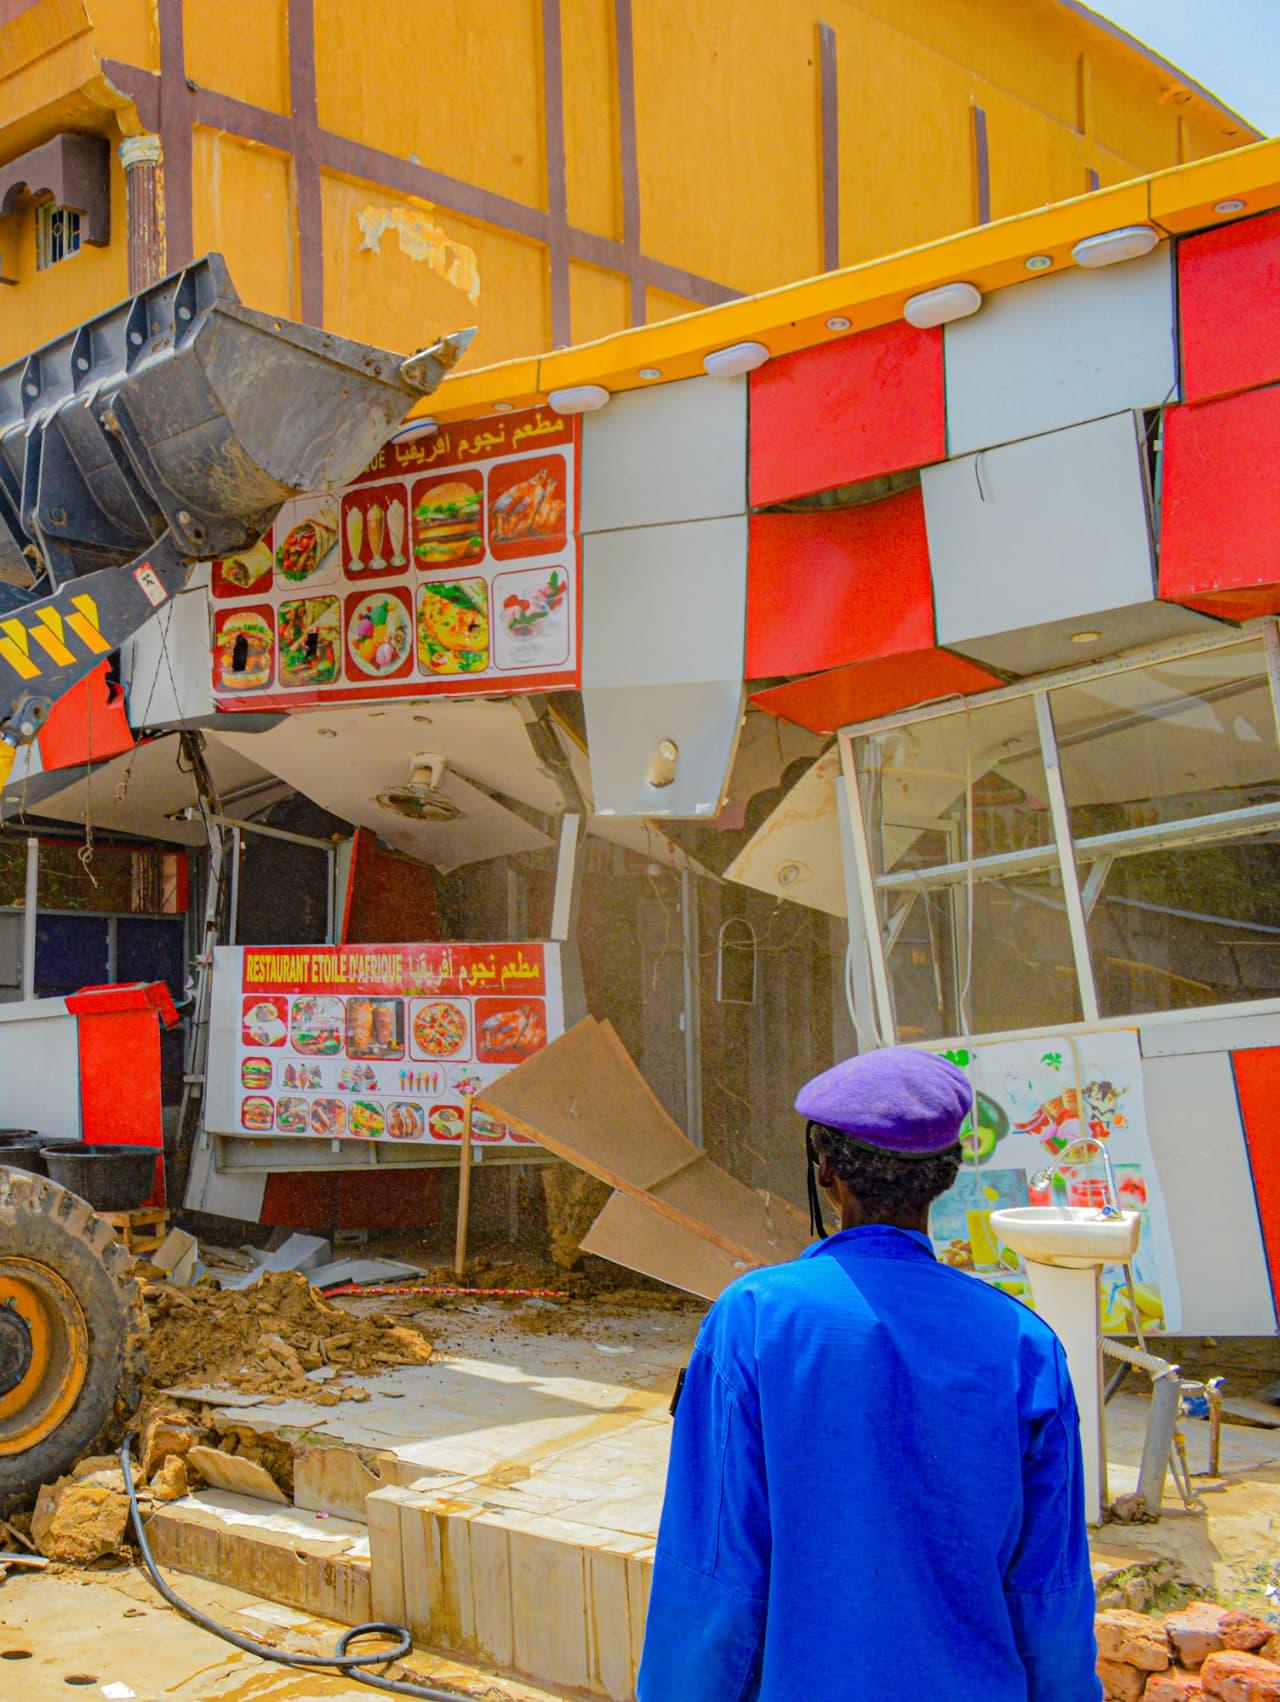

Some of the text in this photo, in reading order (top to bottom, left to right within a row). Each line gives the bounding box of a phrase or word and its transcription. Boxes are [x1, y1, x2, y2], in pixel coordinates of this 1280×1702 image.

[458, 423, 505, 459] نجوم
[511, 413, 564, 448] مطعم
[246, 954, 309, 983] RESTAURANT
[311, 954, 347, 983] ETOILE
[458, 954, 496, 991] نجوم
[500, 951, 540, 990] مطعم
